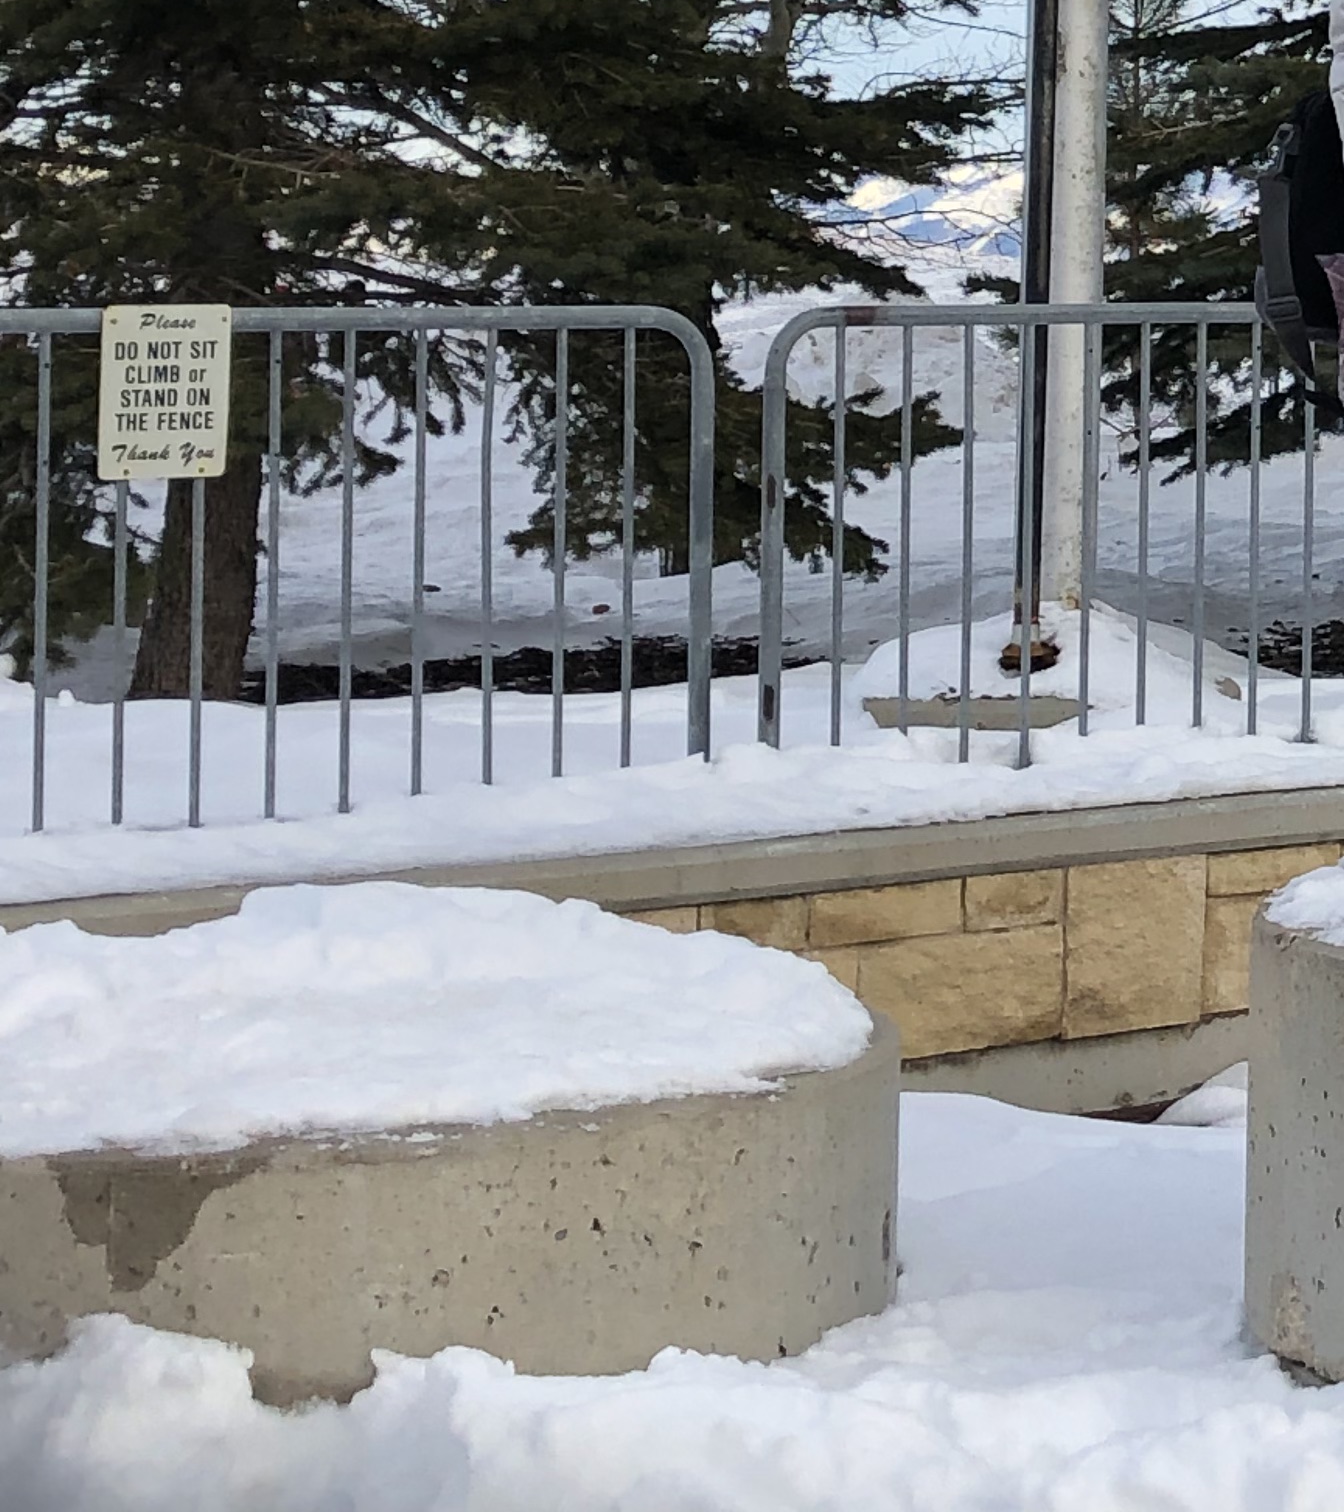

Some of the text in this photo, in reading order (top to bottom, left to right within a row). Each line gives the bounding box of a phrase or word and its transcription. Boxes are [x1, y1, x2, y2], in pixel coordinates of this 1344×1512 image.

[139, 313, 196, 330] Please
[114, 340, 218, 360] DO NOT SIT
[125, 365, 207, 384] CLIMB or
[120, 388, 210, 408] STAND ON
[115, 411, 214, 432] THE FENCE
[112, 441, 215, 467] Thank You
